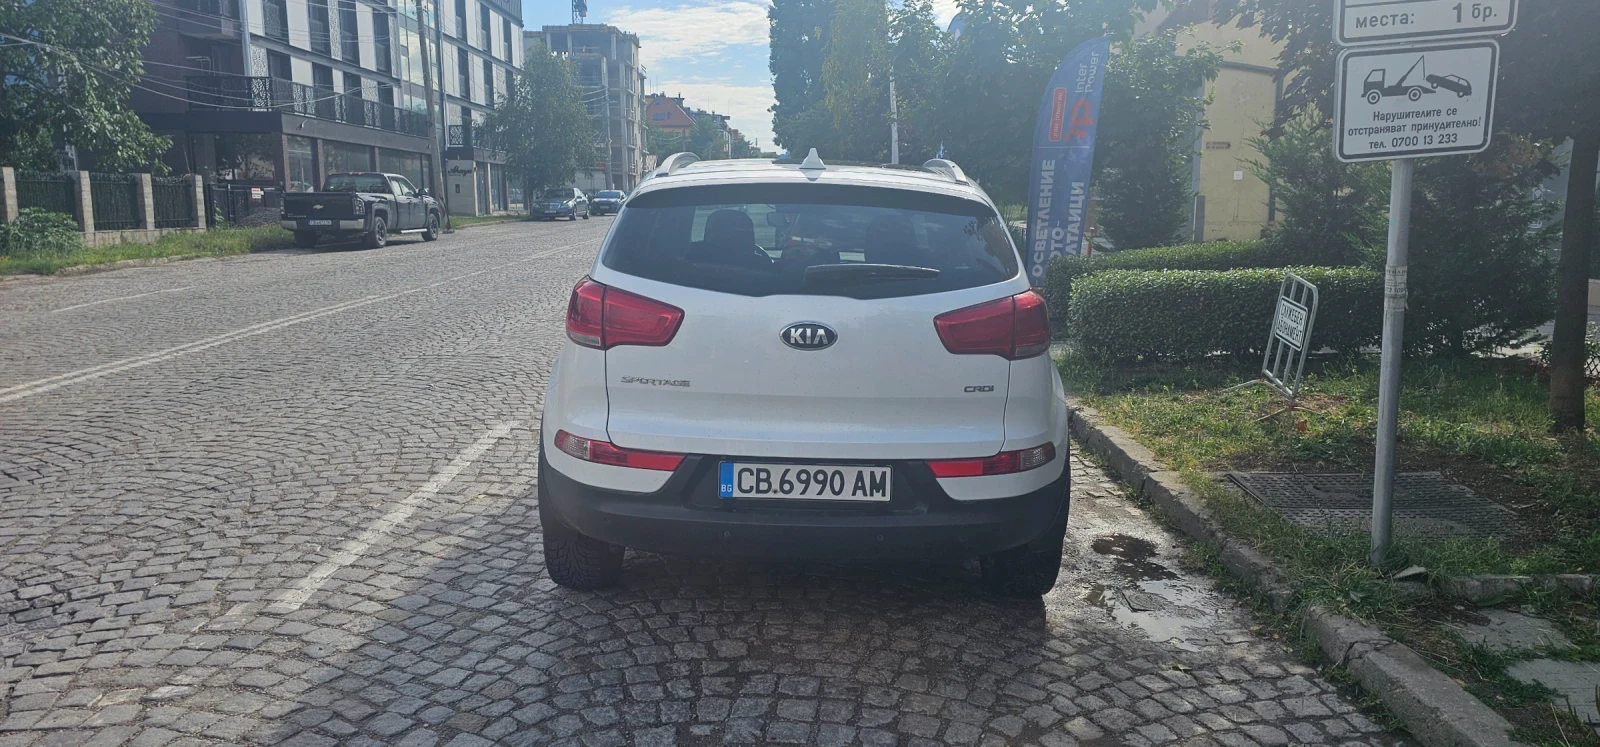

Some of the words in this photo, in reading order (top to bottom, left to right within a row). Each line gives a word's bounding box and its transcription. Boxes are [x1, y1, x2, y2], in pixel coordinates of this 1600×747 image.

[1355, 13, 1415, 29] места:
[1452, 2, 1463, 23] 1
[1471, 3, 1498, 22] бр.
[1075, 63, 1088, 93] Inter
[1084, 51, 1100, 93] Power
[1348, 123, 1407, 137] отстраняват
[1410, 116, 1481, 133] принудително!
[1373, 108, 1442, 122] Нарушителите
[1446, 108, 1458, 116] се
[1369, 139, 1387, 150] тел.
[1391, 135, 1418, 148] 0700
[1423, 134, 1433, 146] 13
[1438, 133, 1458, 145] 233
[1065, 181, 1085, 258] ЛТАИЦИ
[1049, 220, 1065, 258] ОТО-
[790, 328, 828, 346] KIA
[620, 375, 691, 388] SPORTAGE
[721, 484, 732, 493] BG
[778, 468, 846, 497] 6990
[851, 470, 887, 498] AM
